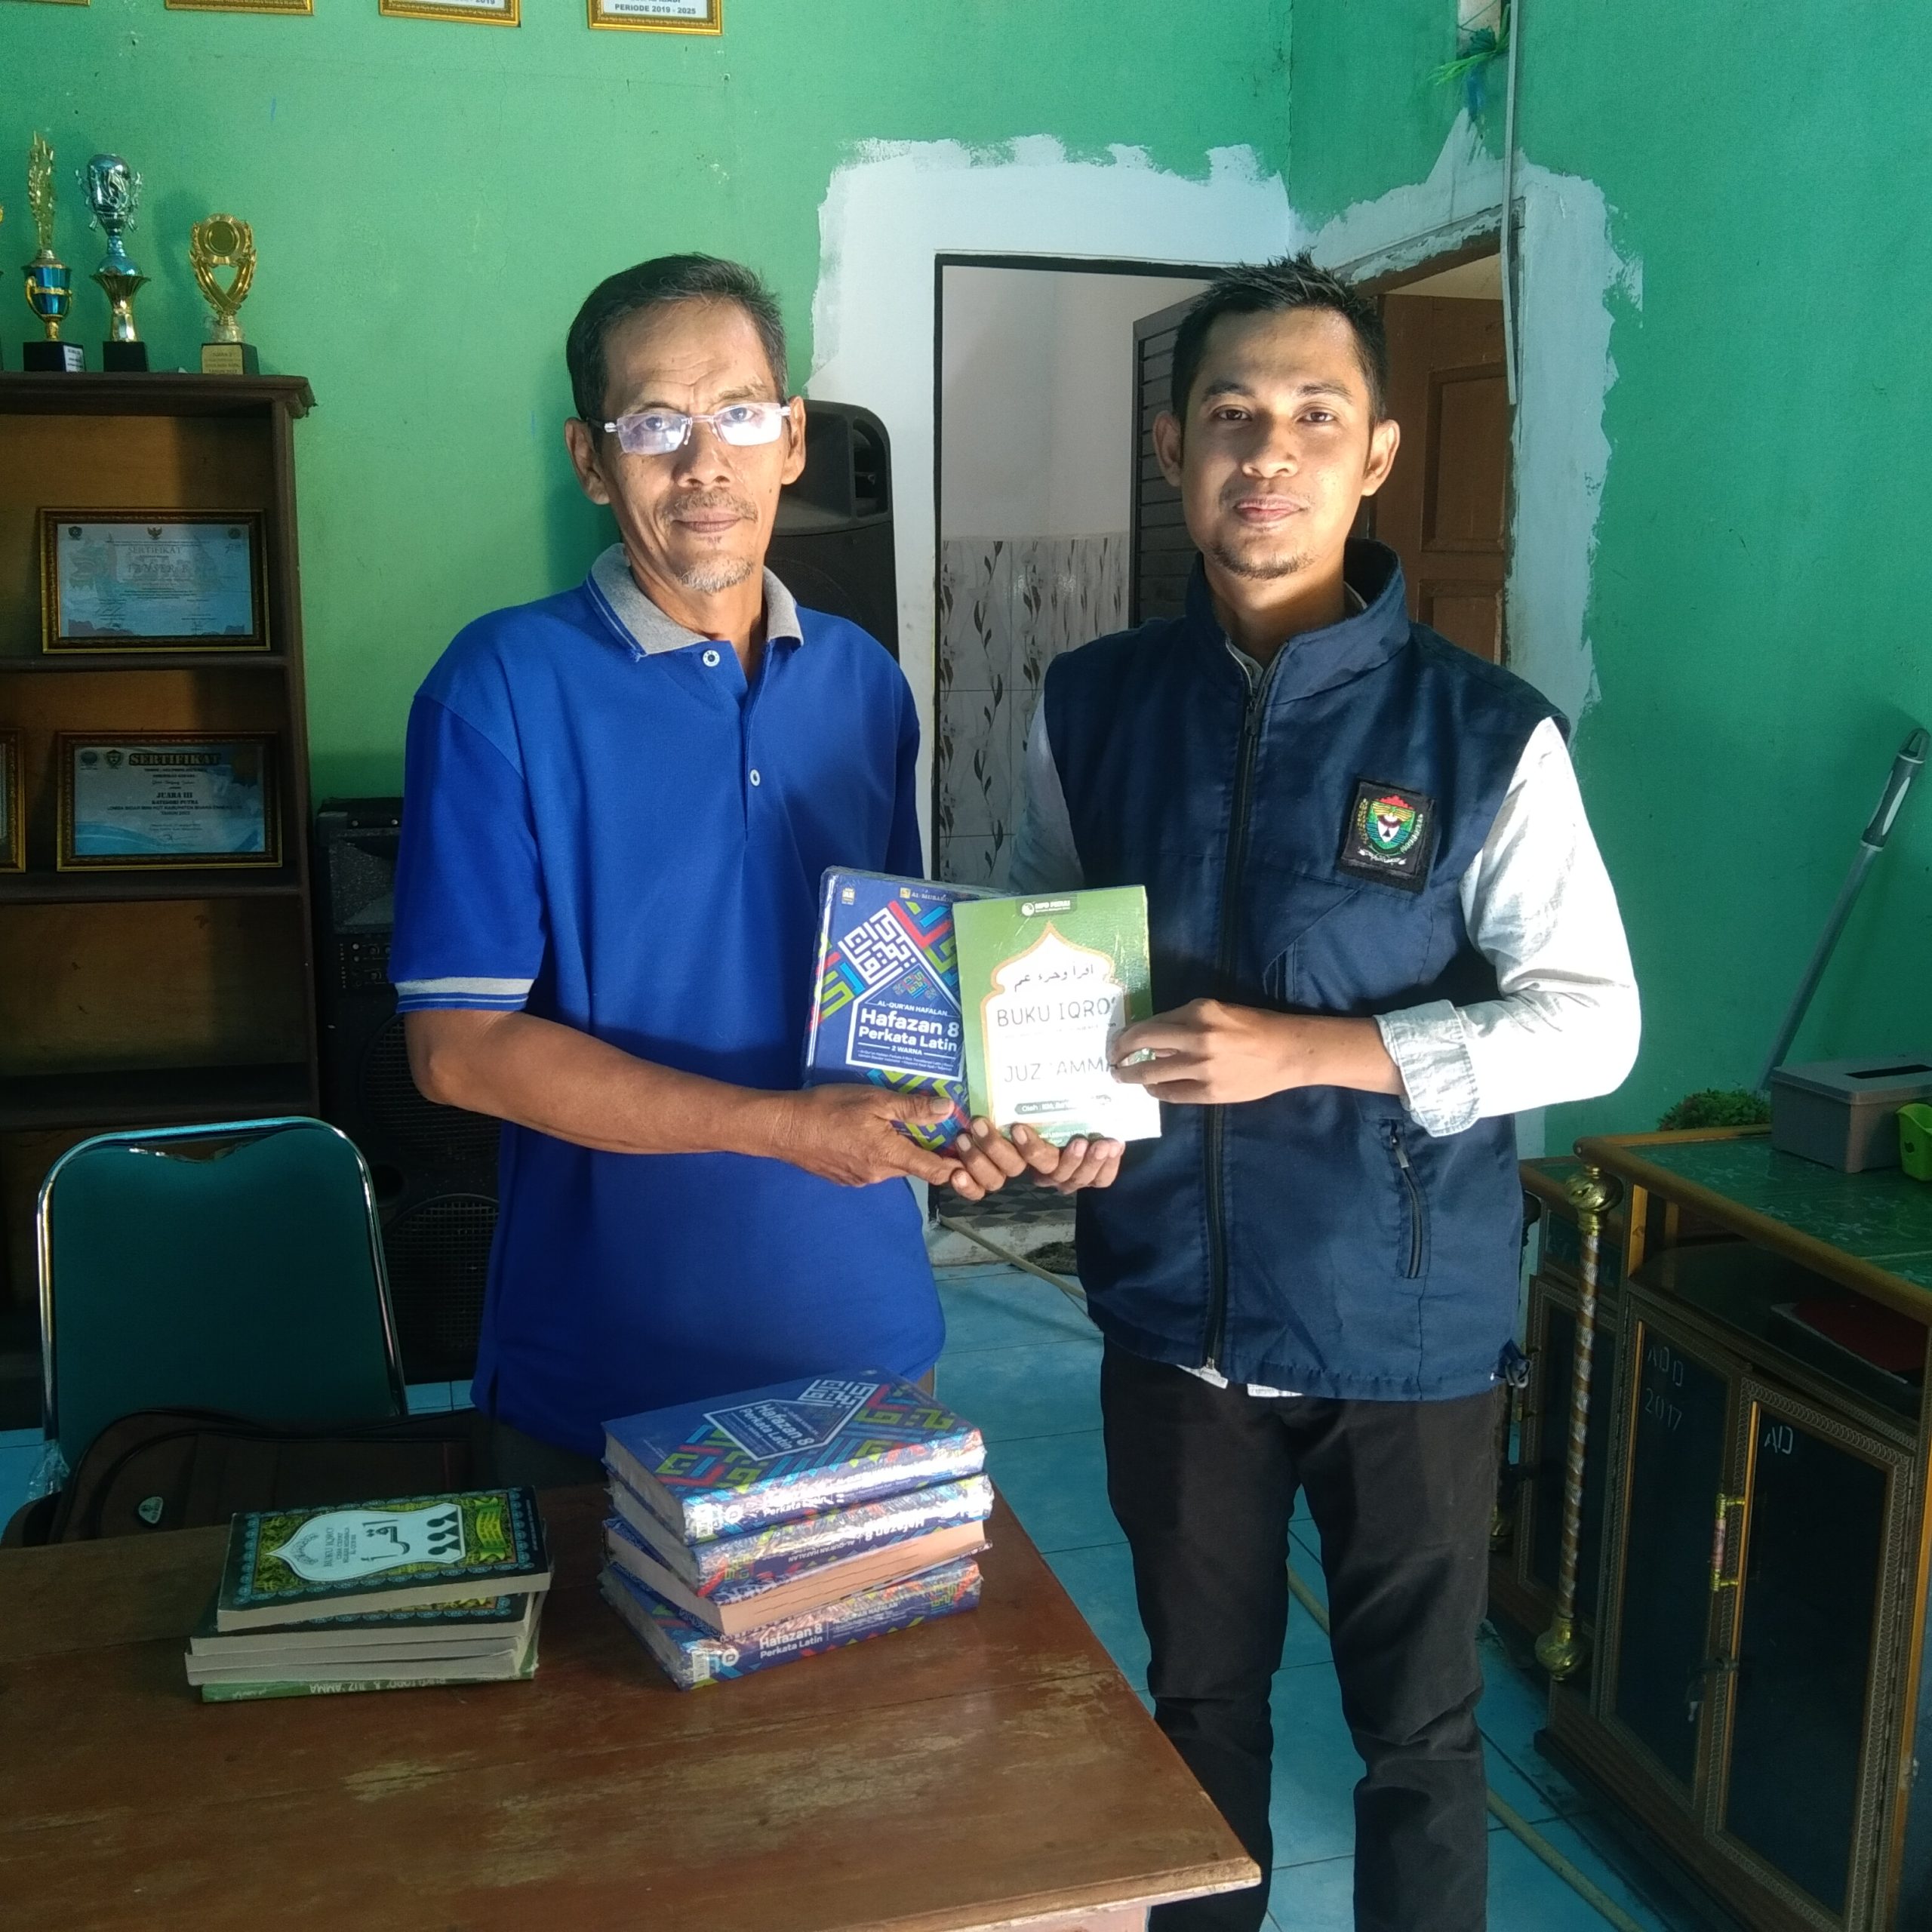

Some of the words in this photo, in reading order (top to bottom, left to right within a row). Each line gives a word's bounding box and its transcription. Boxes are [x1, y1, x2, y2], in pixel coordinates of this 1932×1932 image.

[128, 546, 182, 555] SERTIFIKAT
[129, 753, 220, 765] SERTIFIKAT
[878, 1001, 915, 1011] AL-QUR'AN
[915, 1005, 947, 1016] HAFALAN
[997, 1004, 1050, 1027] BUKU
[1060, 996, 1115, 1020] IQRO'
[860, 1008, 943, 1035] Hafazan
[947, 1022, 960, 1037] 8
[859, 1026, 917, 1045] Perkata
[919, 1035, 957, 1051] Latin
[897, 1046, 922, 1055] WARNA
[1004, 1063, 1041, 1082] JUZ
[1644, 1387, 1682, 1431] 2017
[740, 1407, 773, 1433] Perkata
[768, 1432, 792, 1449] Latin
[754, 1404, 803, 1439] Hafazan
[797, 1438, 815, 1446] 8
[764, 1502, 802, 1515] Perkata
[788, 1547, 823, 1562] HAFALAN
[759, 1628, 808, 1650] Hafazan
[814, 1623, 823, 1634] 8
[760, 1644, 797, 1659] Perkata
[799, 1636, 823, 1648] Latin
[309, 1682, 345, 1694] 'AMMA
